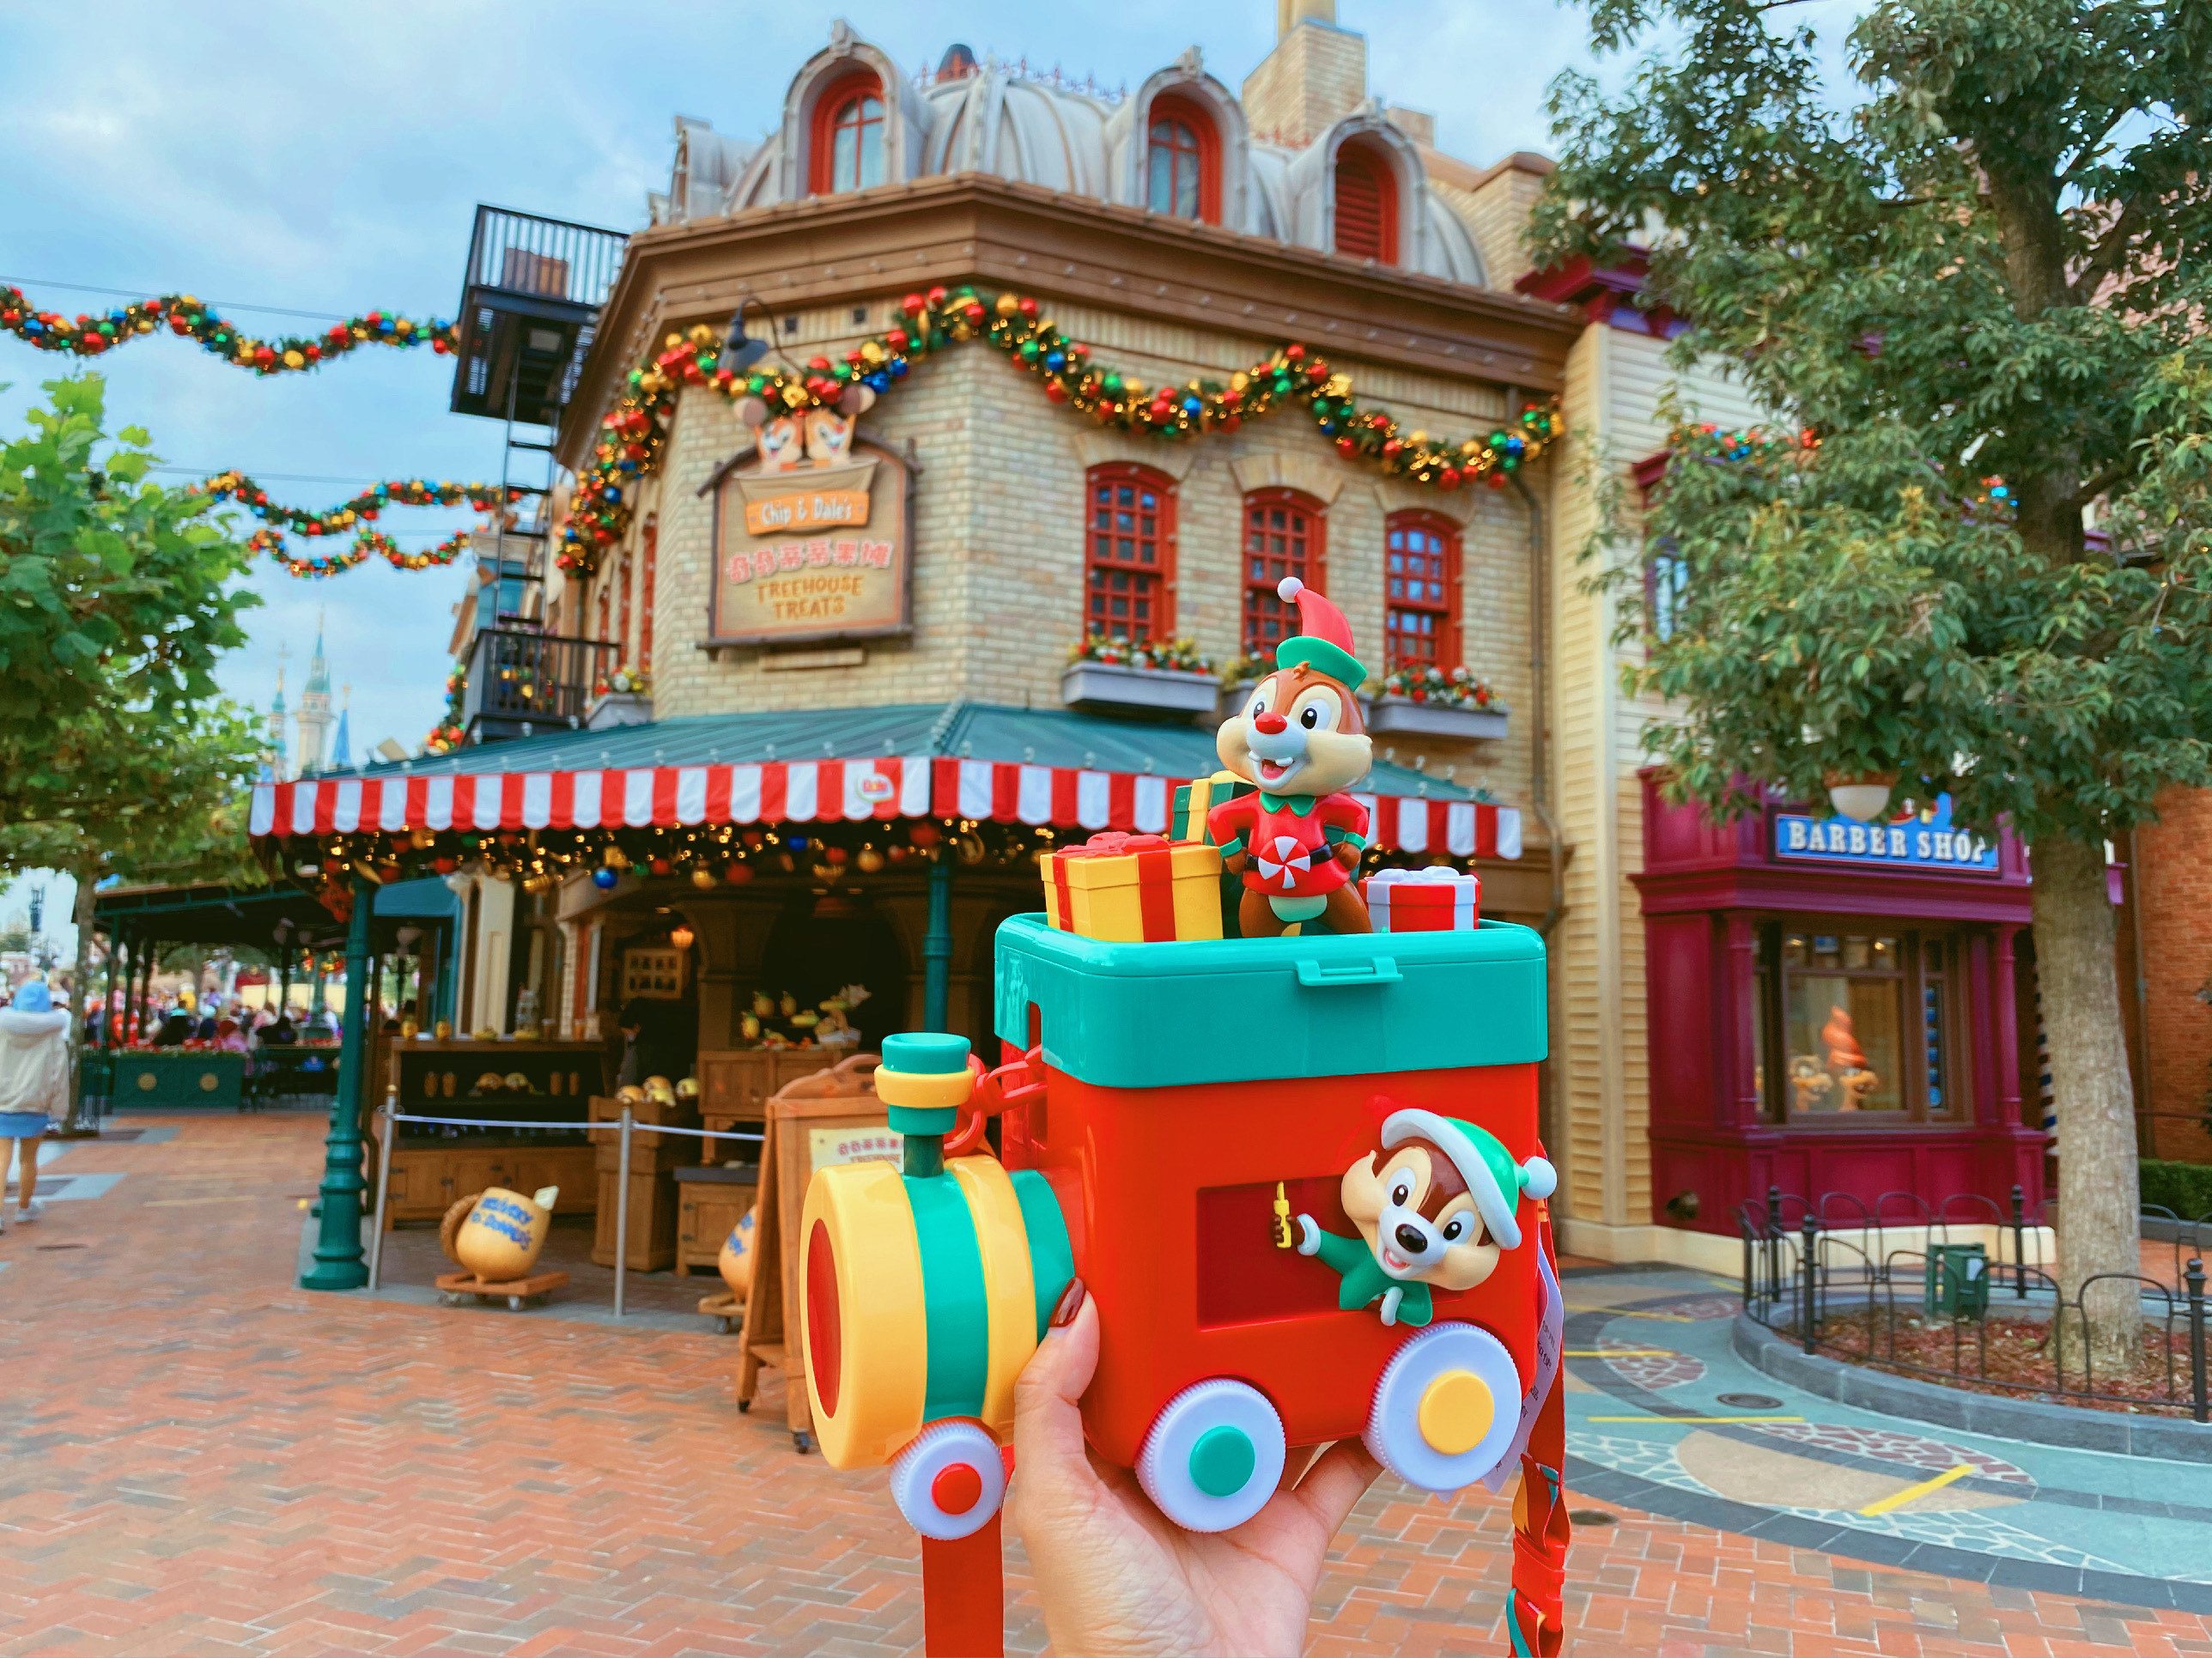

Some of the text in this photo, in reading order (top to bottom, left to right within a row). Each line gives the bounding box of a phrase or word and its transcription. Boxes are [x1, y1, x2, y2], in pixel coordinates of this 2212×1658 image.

[762, 501, 792, 525] Chip
[813, 495, 852, 521] Dale's
[757, 575, 865, 604] TREEHOUSE
[773, 595, 846, 620] TREATS
[1789, 819, 1907, 857] BARBER
